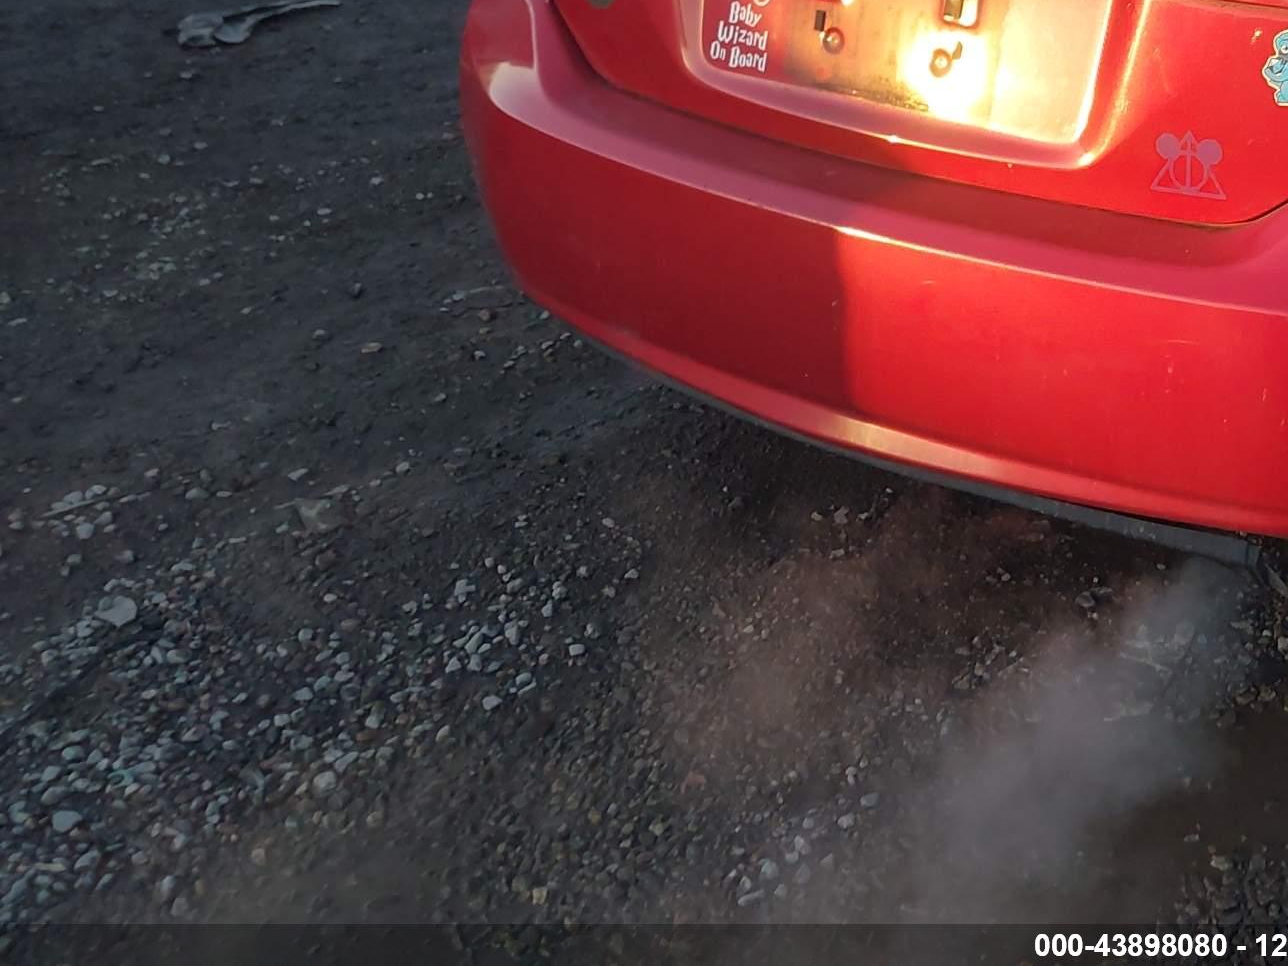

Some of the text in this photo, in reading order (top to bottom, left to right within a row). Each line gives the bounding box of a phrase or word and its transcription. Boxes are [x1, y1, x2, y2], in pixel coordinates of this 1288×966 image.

[729, 1, 762, 28] Baby
[718, 20, 768, 51] Wizard
[710, 40, 768, 73] On Board
